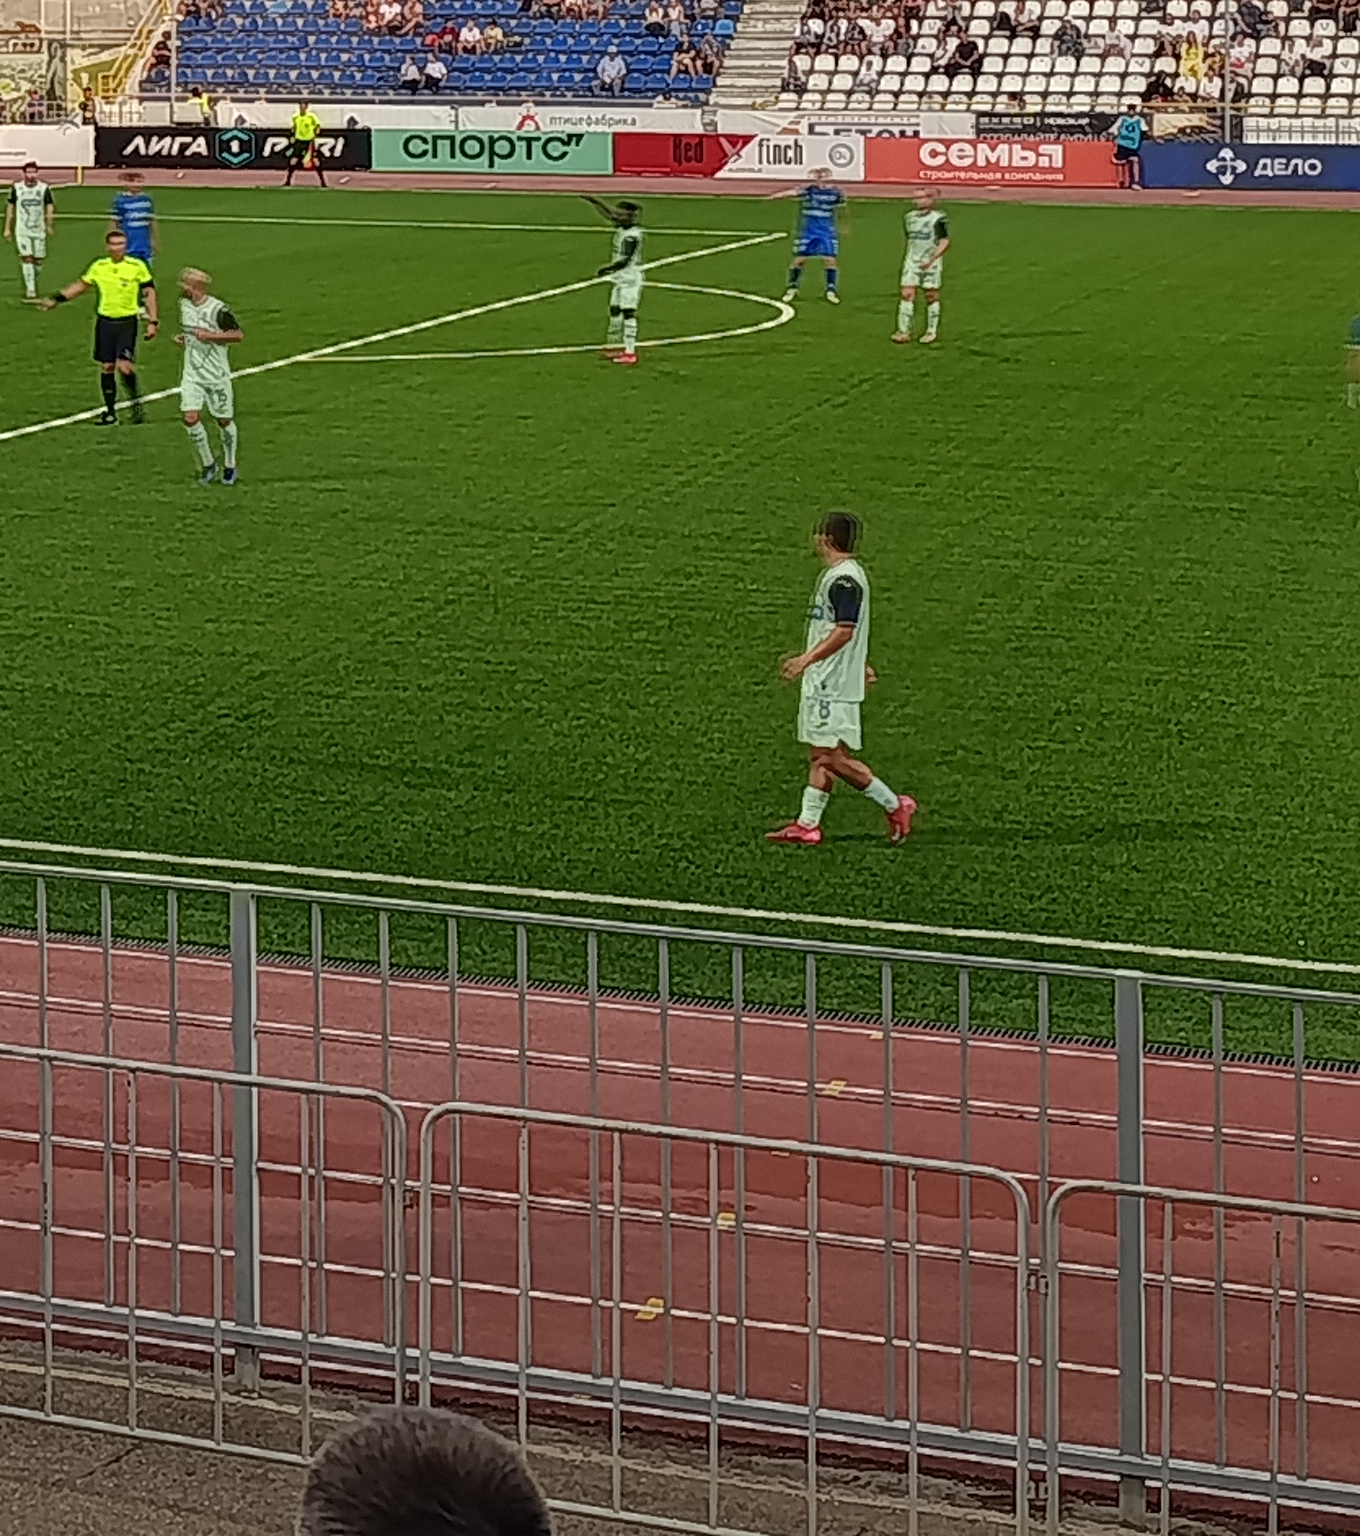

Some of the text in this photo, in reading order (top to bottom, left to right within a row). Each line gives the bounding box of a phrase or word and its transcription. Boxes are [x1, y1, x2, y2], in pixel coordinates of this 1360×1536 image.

[549, 115, 637, 128] птицефабрика
[123, 135, 209, 156] ЛИГА
[262, 136, 345, 157] PRI
[758, 138, 803, 165] finch
[1254, 158, 1323, 177] ДЕЛО
